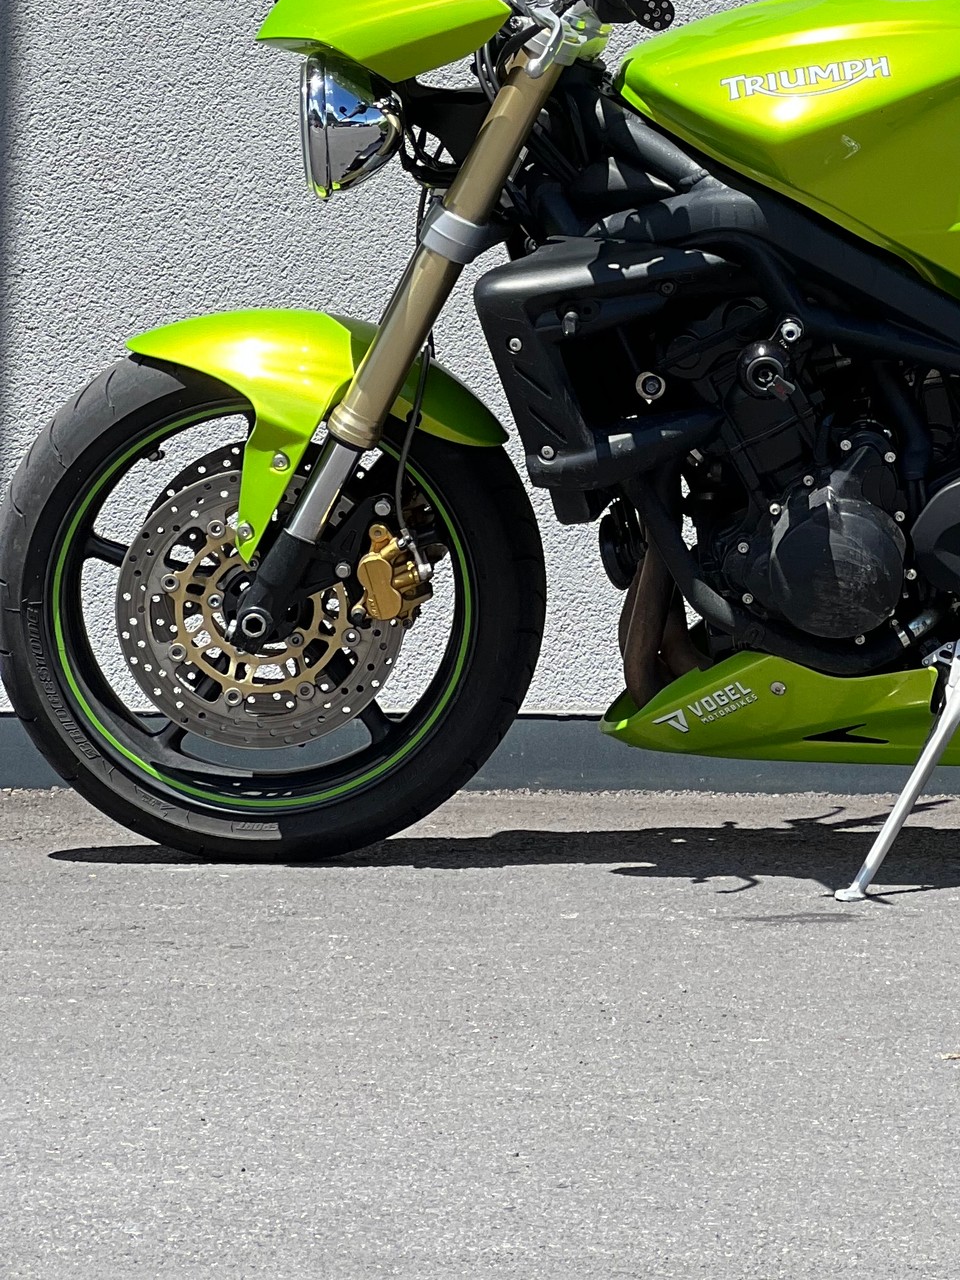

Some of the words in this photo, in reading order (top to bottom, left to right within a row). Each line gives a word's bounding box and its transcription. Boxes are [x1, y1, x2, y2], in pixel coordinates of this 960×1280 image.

[720, 56, 891, 101] TRIUMPH
[687, 681, 752, 718] VOGEL
[700, 693, 759, 725] MOTORBIKES
